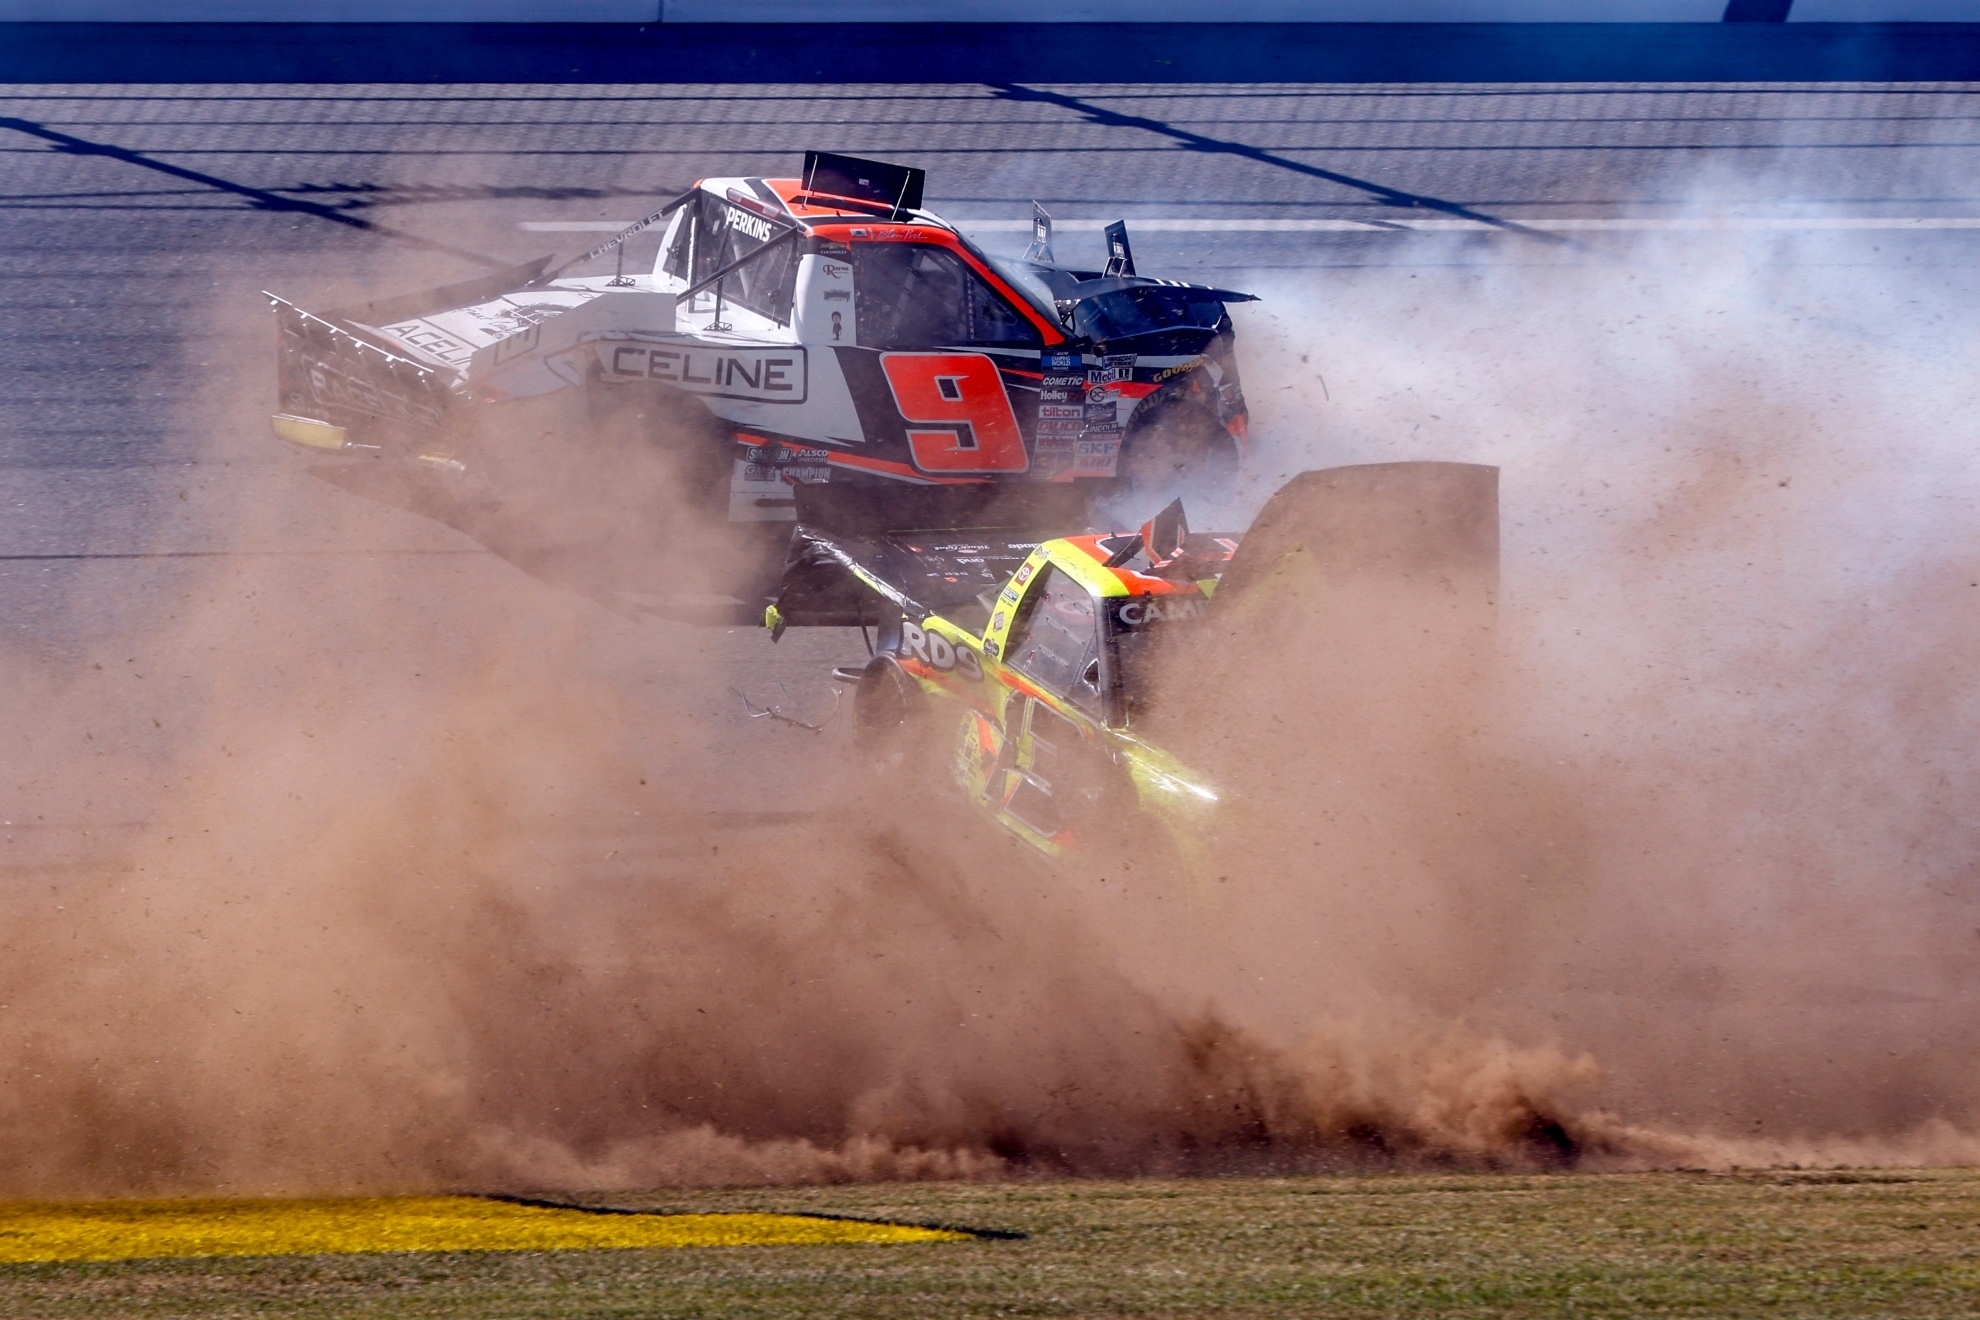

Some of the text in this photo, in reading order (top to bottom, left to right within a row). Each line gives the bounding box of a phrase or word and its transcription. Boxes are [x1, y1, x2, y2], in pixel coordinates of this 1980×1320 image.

[725, 207, 772, 243] PERKINS
[590, 210, 662, 258] CHEVROLET
[598, 345, 794, 391] CELINE
[1091, 369, 1116, 382] Mobil
[1043, 377, 1083, 386] COMETIC
[1040, 390, 1068, 403] Holley
[879, 351, 1029, 473] 9
[1041, 406, 1080, 417] tilton
[1038, 421, 1082, 431] CALICO
[1086, 423, 1118, 432] LINCOLN
[799, 449, 829, 457] ALSCO
[1078, 443, 1114, 453] SKF
[782, 467, 831, 478] CHAMPION
